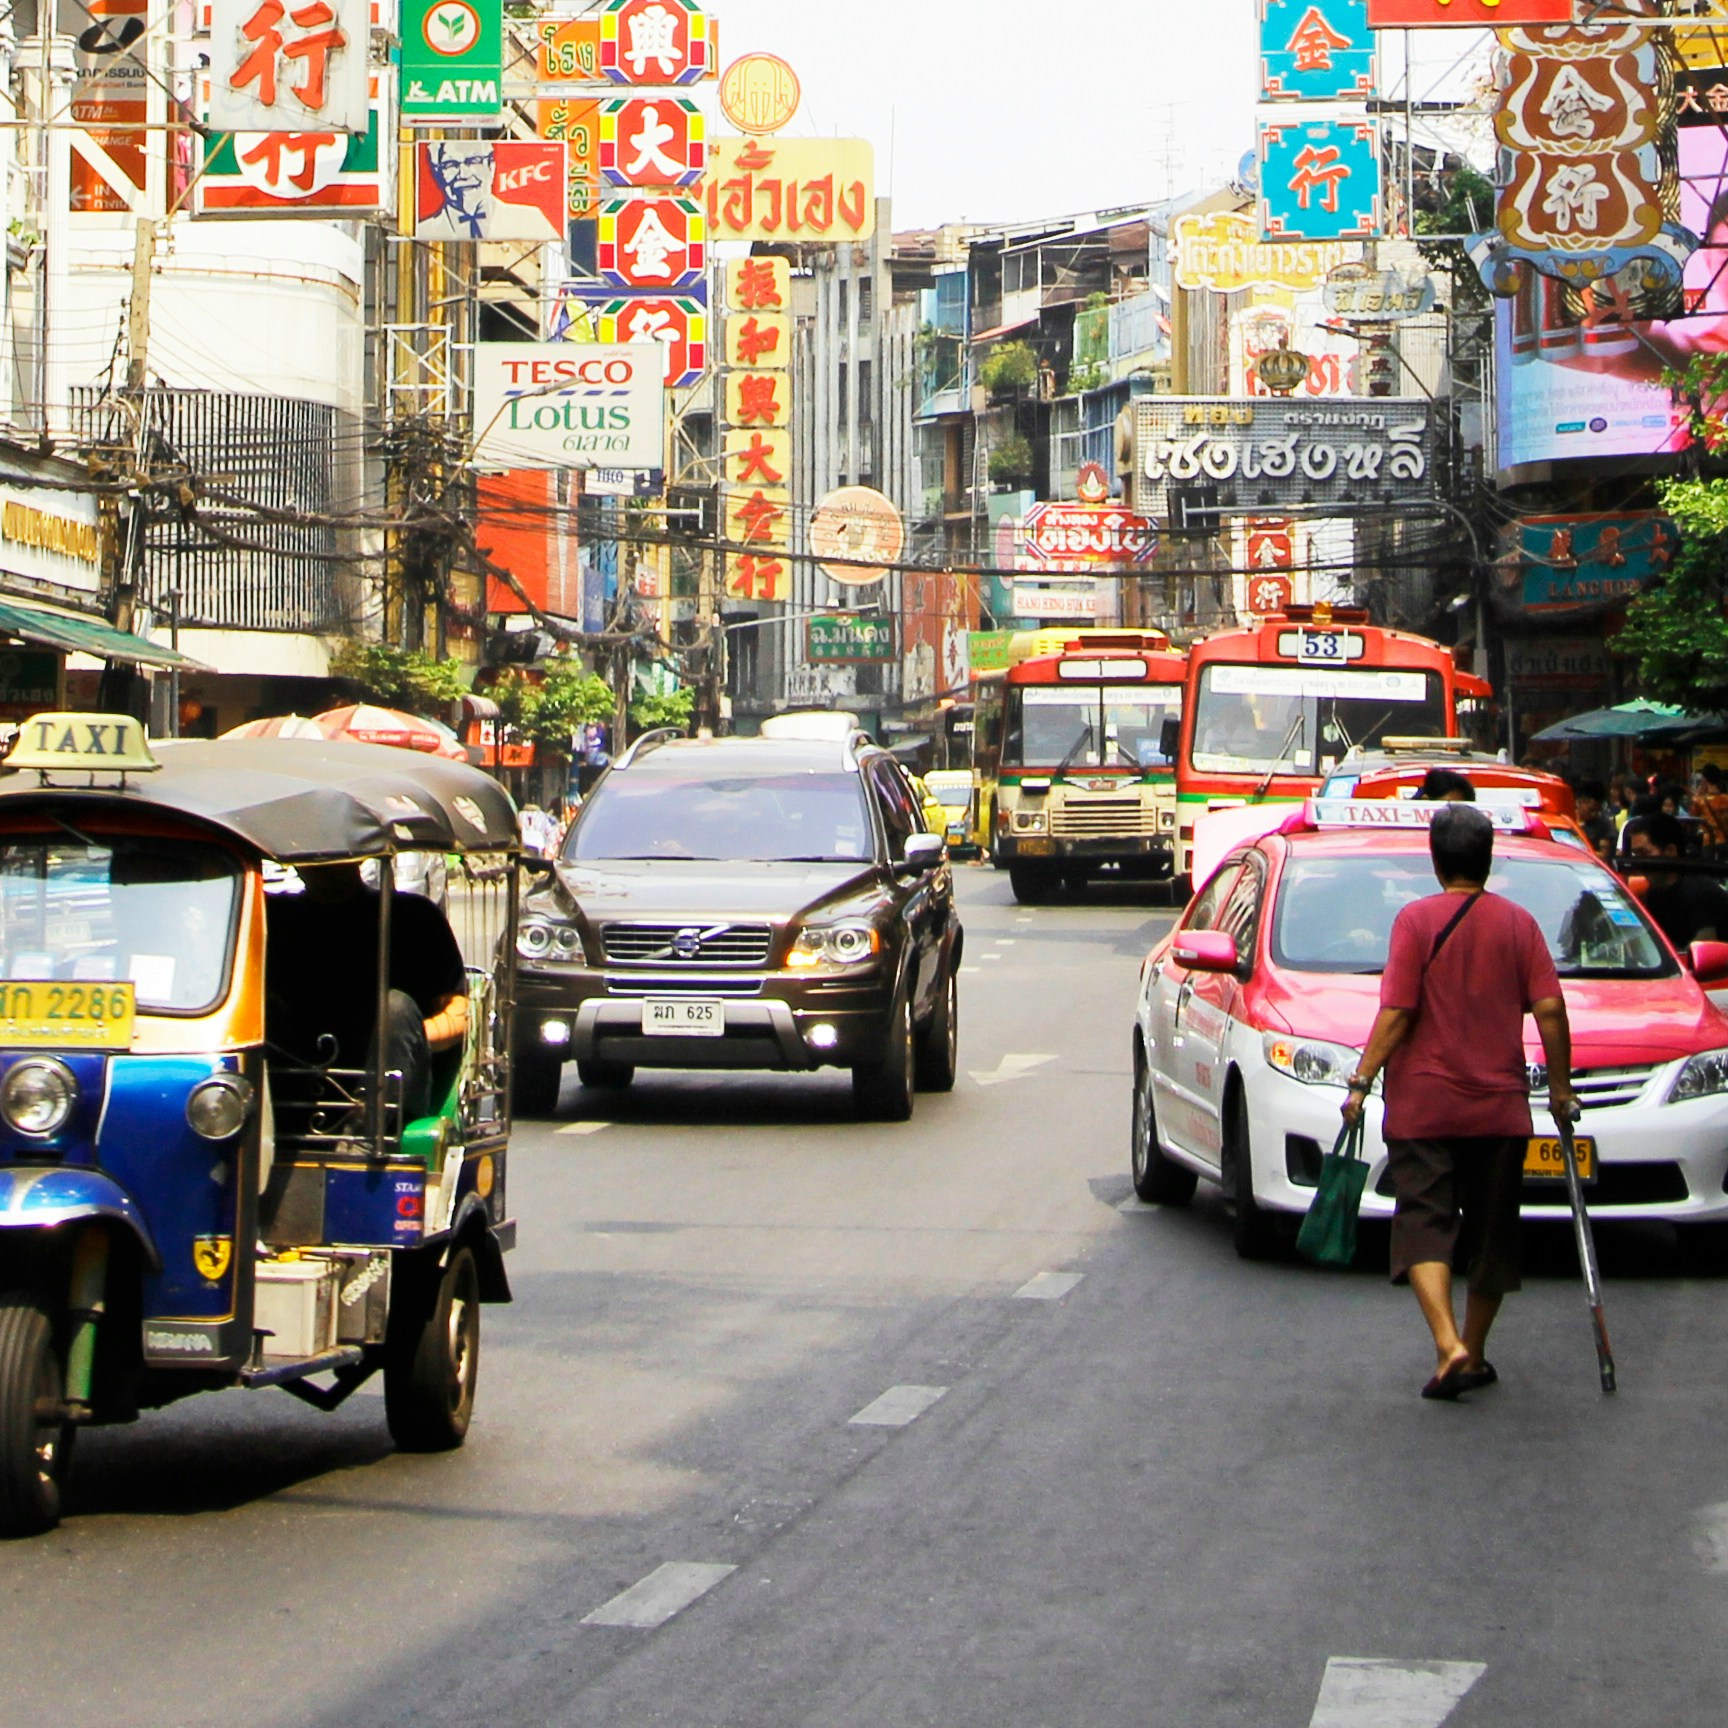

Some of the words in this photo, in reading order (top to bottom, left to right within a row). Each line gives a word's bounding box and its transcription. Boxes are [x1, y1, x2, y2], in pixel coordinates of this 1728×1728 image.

[436, 80, 498, 104] ATM
[498, 160, 554, 192] KFC
[502, 359, 633, 385] TESCO
[509, 397, 631, 431] Lotus
[562, 433, 631, 452] ตลาด
[1304, 632, 1339, 659] 53
[35, 721, 129, 756] TAXI
[1345, 805, 1494, 823] TAXI-MR
[47, 986, 126, 1019] 2286
[687, 1005, 713, 1020] 625
[1539, 1141, 1587, 1162] 665
